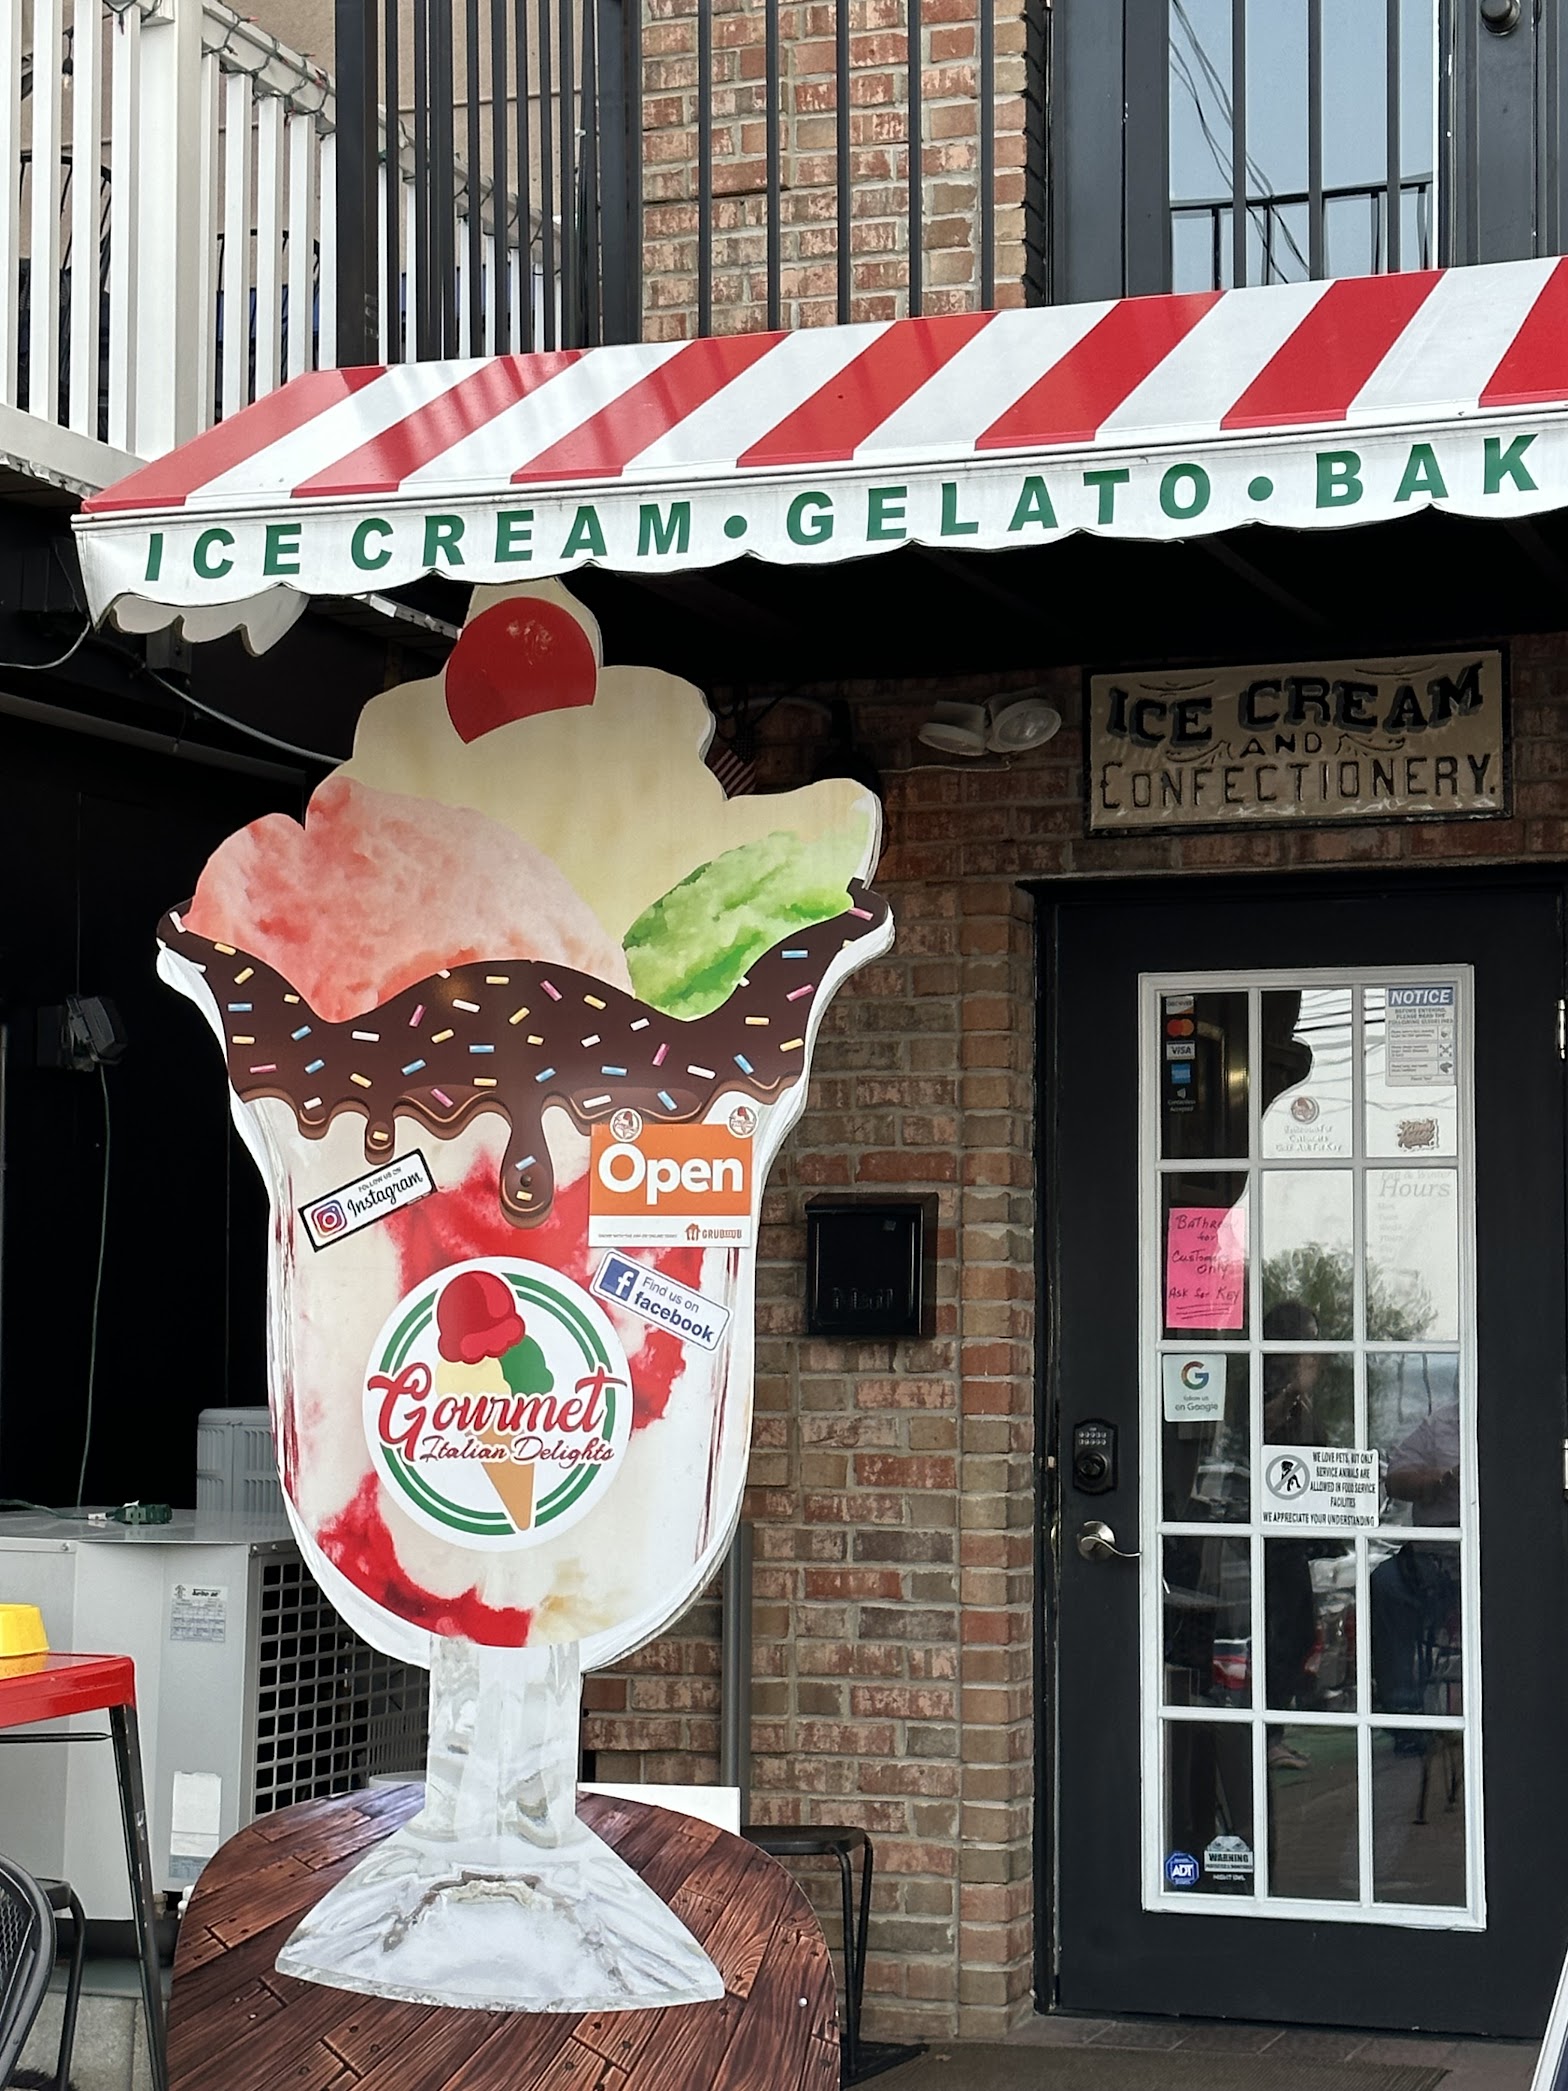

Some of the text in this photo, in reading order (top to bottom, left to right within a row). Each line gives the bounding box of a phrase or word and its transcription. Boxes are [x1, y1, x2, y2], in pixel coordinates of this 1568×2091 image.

[144, 433, 1540, 582] ICE CREAM GELATO BAK
[1106, 660, 1483, 748] ICE CREAM
[1240, 732, 1323, 758] AND
[1391, 989, 1451, 1004] NOTICE
[1171, 1046, 1192, 1055] VISA
[598, 1143, 743, 1205] Open
[347, 1172, 423, 1217] Instagram
[1380, 1180, 1451, 1197] Hours
[615, 1271, 634, 1296] f
[642, 1276, 699, 1313] Find us on
[634, 1291, 715, 1343] facebook
[1181, 1361, 1209, 1390] G
[367, 1362, 628, 1462] Gourmet
[1187, 1402, 1218, 1412] Google
[419, 1435, 614, 1468] Italian Delights
[1313, 1452, 1320, 1462] WE
[1321, 1452, 1335, 1463] LOVE
[1360, 1453, 1374, 1464] ONLY
[1316, 1466, 1338, 1478] SERVICE
[1360, 1468, 1370, 1479] ARE
[1310, 1481, 1335, 1492] ALLOWED
[1354, 1483, 1376, 1494] SERVICE
[1263, 1511, 1375, 1527] WE APPRECIATE YOUR UNDERSTANDING
[1208, 1853, 1249, 1862] WARNING
[1171, 1864, 1194, 1877] ADT
